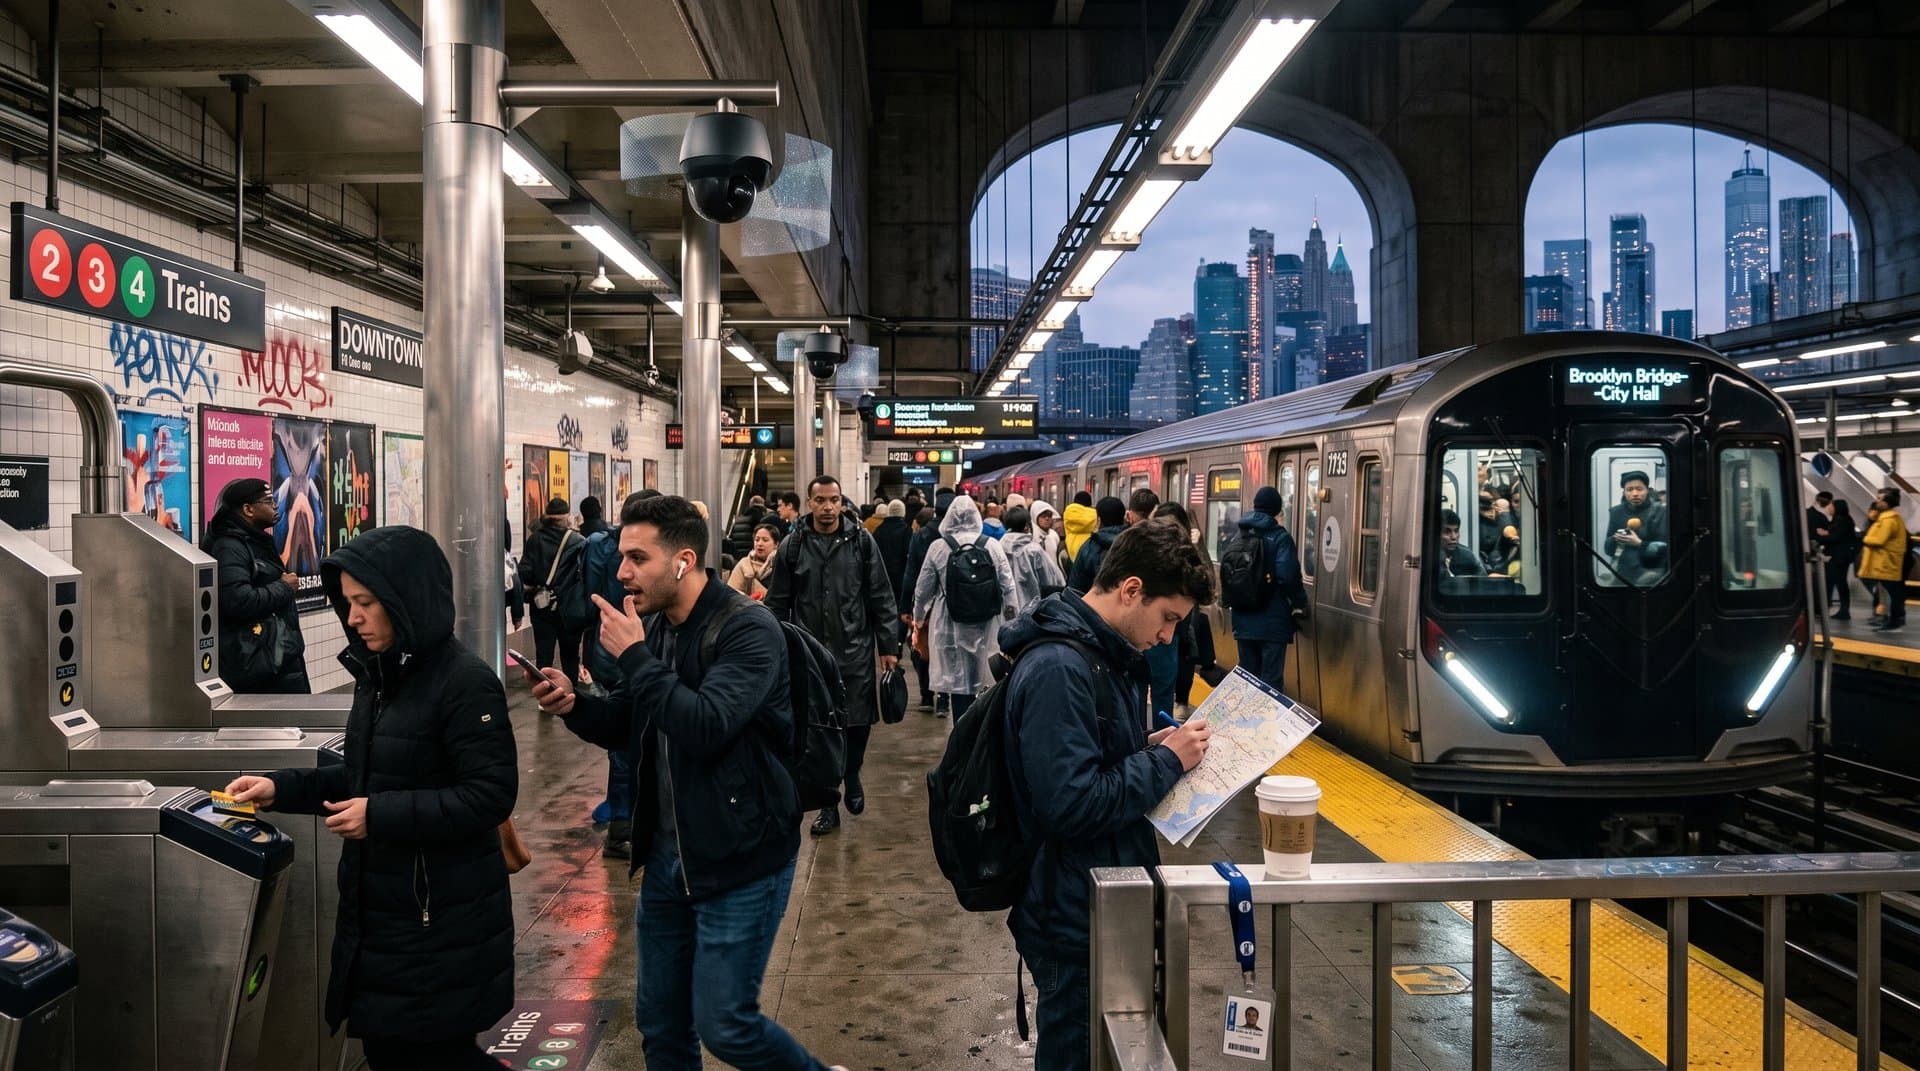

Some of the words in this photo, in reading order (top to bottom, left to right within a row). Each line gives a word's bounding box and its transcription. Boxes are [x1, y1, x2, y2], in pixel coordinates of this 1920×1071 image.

[42, 243, 60, 283] 2
[88, 257, 105, 293] 3
[129, 270, 146, 304] 4
[162, 268, 231, 324] Trains
[340, 319, 423, 369] DOWNTOWN
[1569, 367, 1633, 386] Brooklyn
[1632, 385, 1660, 401] Hall
[208, 451, 226, 465] and
[486, 1011, 542, 1055] Trains
[535, 1055, 562, 1067] 2
